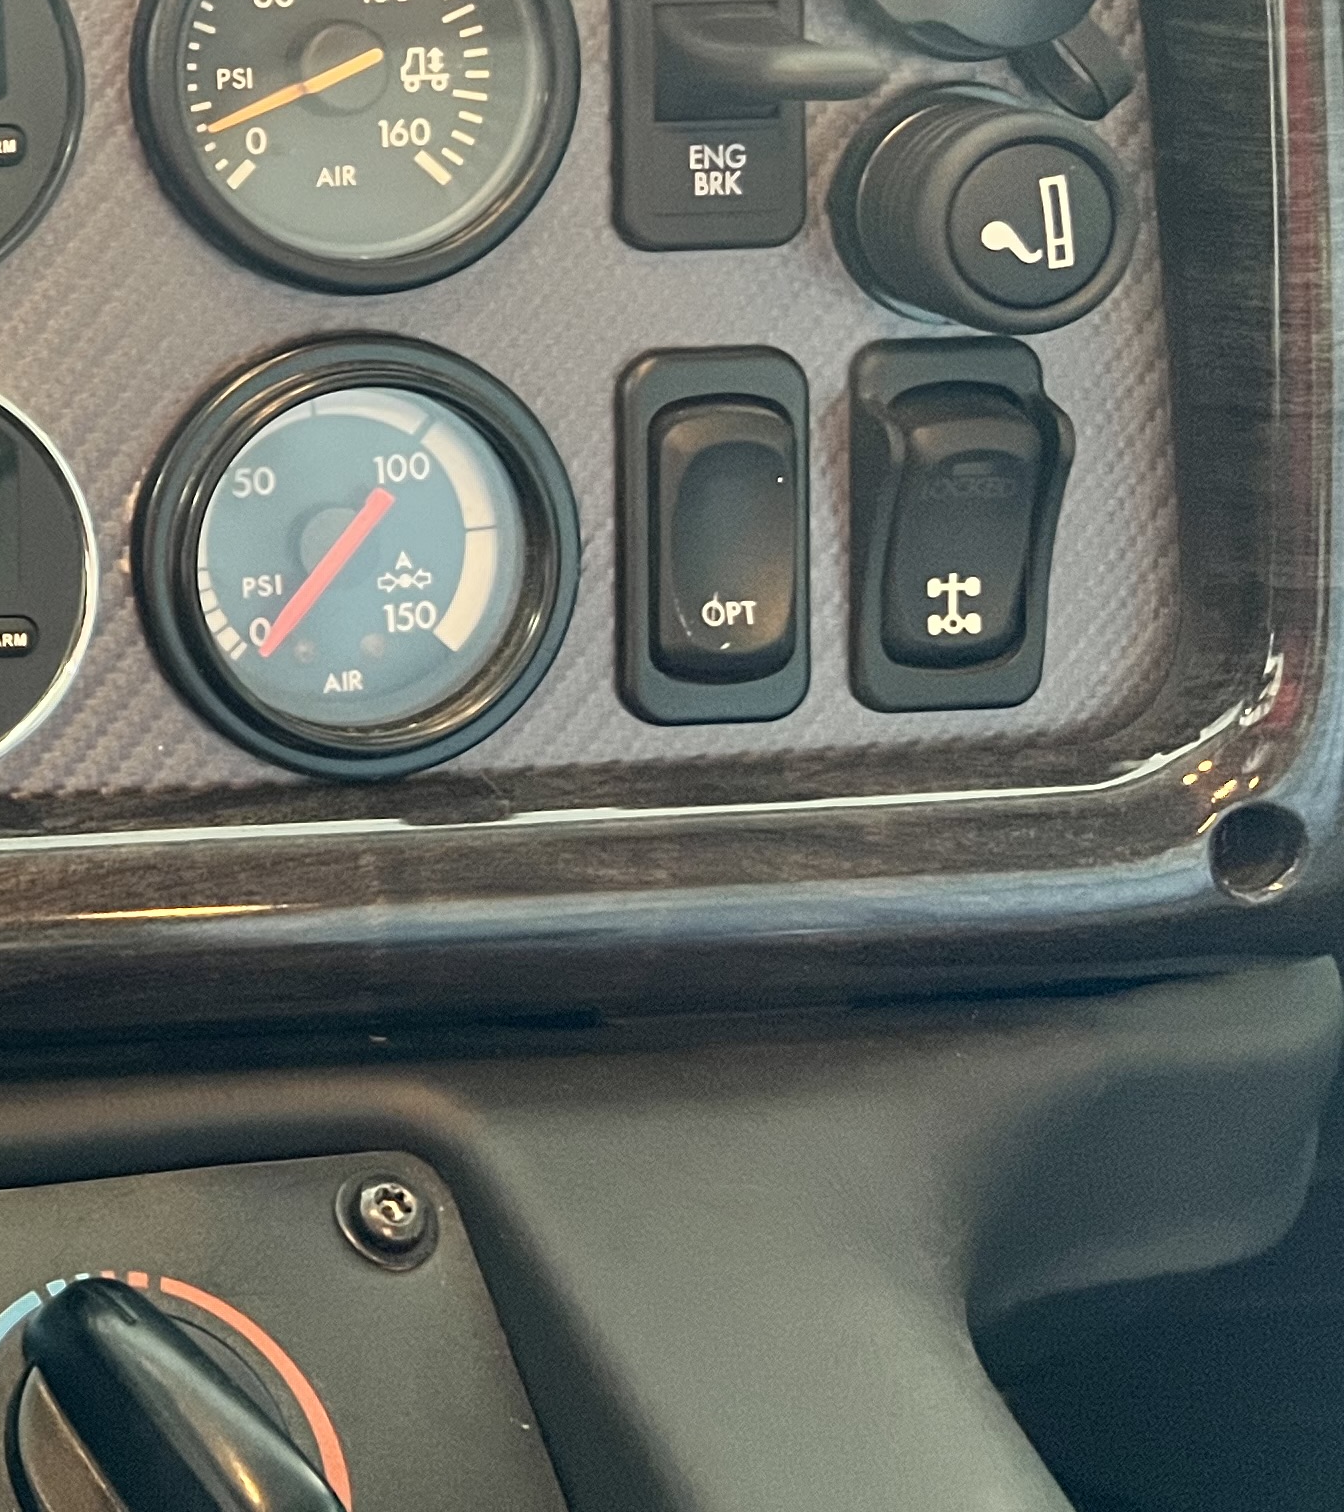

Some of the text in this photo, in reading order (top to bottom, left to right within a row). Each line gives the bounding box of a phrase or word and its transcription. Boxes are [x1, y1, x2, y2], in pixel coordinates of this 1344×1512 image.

[216, 67, 254, 90] PSI
[245, 127, 268, 155] 0
[377, 118, 432, 148] 160
[688, 144, 748, 170] ENG
[315, 165, 357, 187] AIR
[693, 171, 743, 196] BRK
[231, 466, 276, 498] 50
[372, 452, 431, 484] 100
[241, 574, 282, 598] PSI
[383, 600, 437, 634] 150
[701, 598, 757, 627] OPT
[249, 617, 271, 646] 0
[323, 670, 363, 694] AIR
